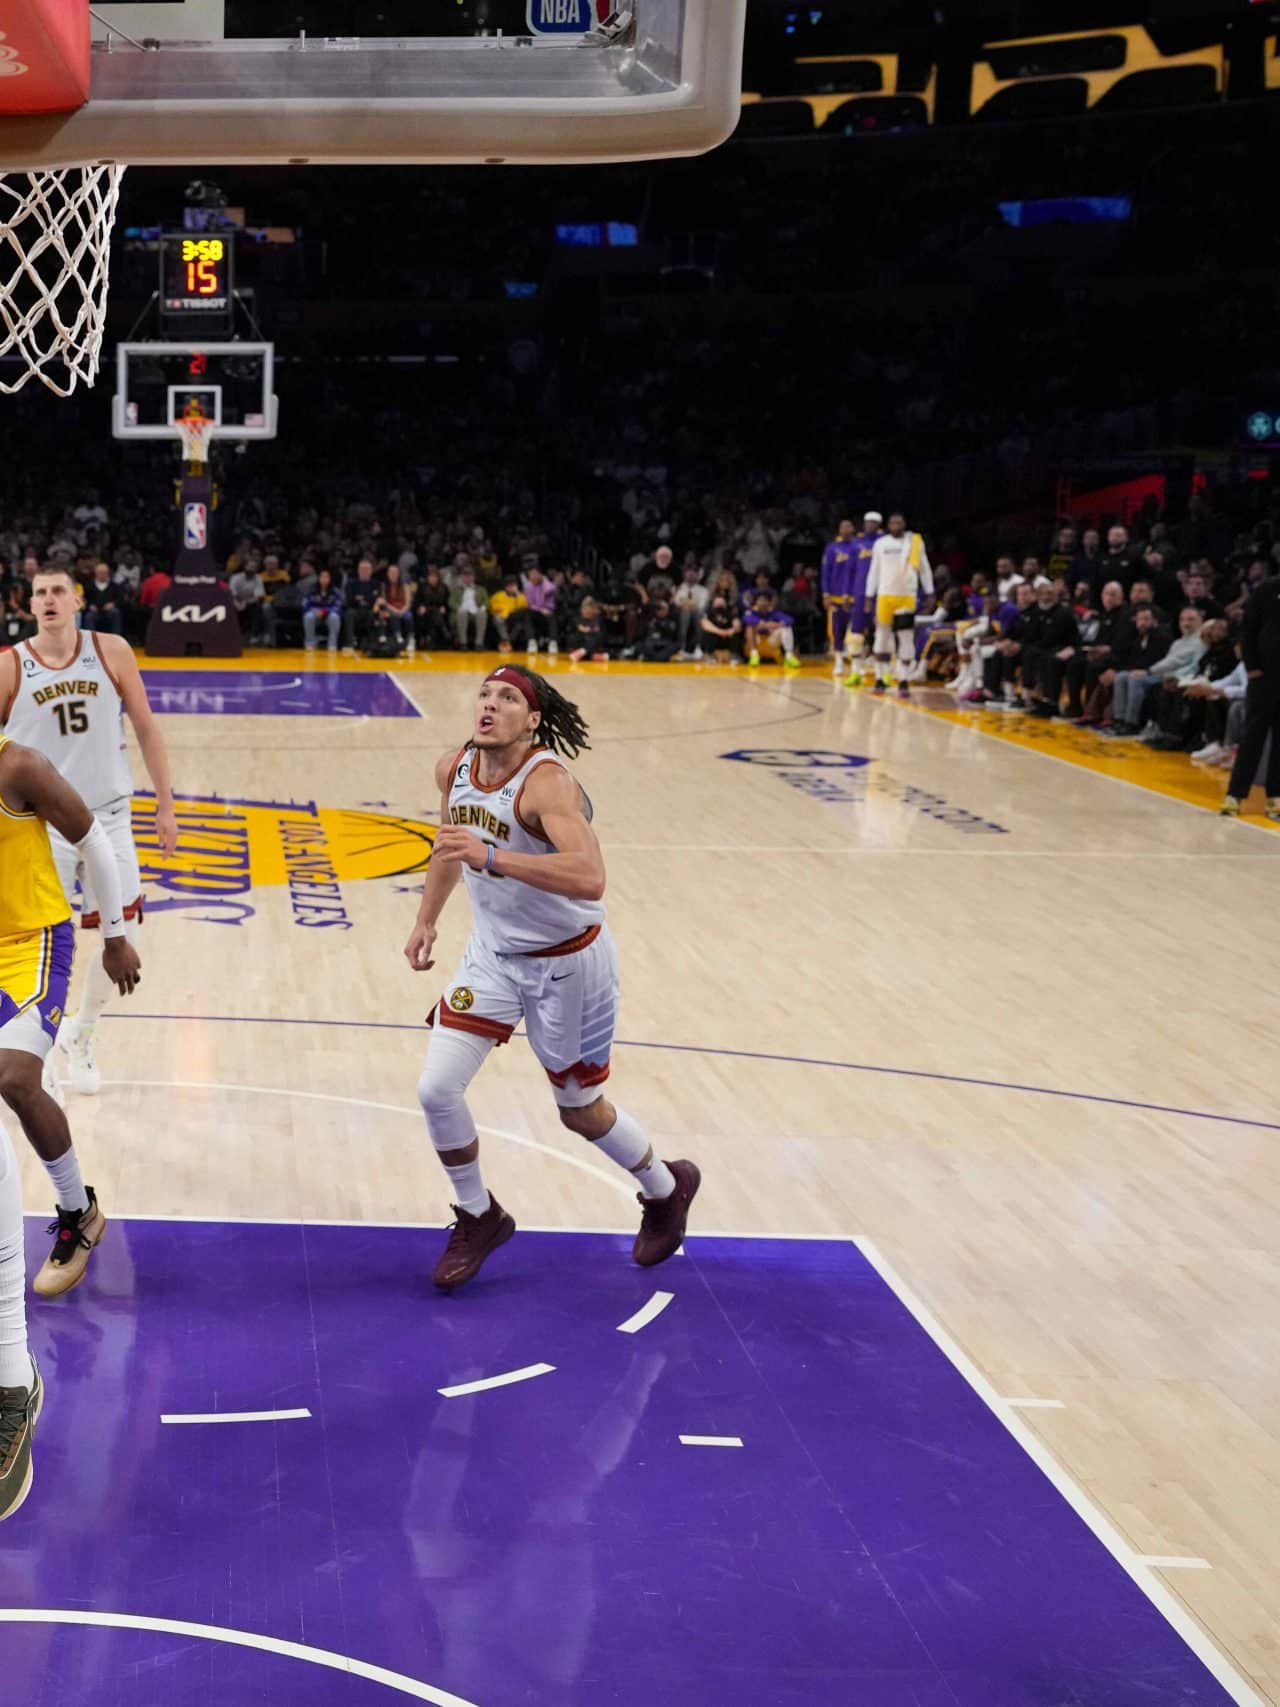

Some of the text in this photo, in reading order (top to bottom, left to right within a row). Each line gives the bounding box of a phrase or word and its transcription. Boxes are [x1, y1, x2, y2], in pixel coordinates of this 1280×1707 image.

[540, 0, 580, 24] NBA
[186, 260, 217, 294] 15
[161, 604, 227, 623] KIA
[31, 680, 100, 706] DENVER
[52, 700, 90, 737] 15
[449, 804, 511, 843] DENVER
[278, 818, 354, 931] LOS ANGELES
